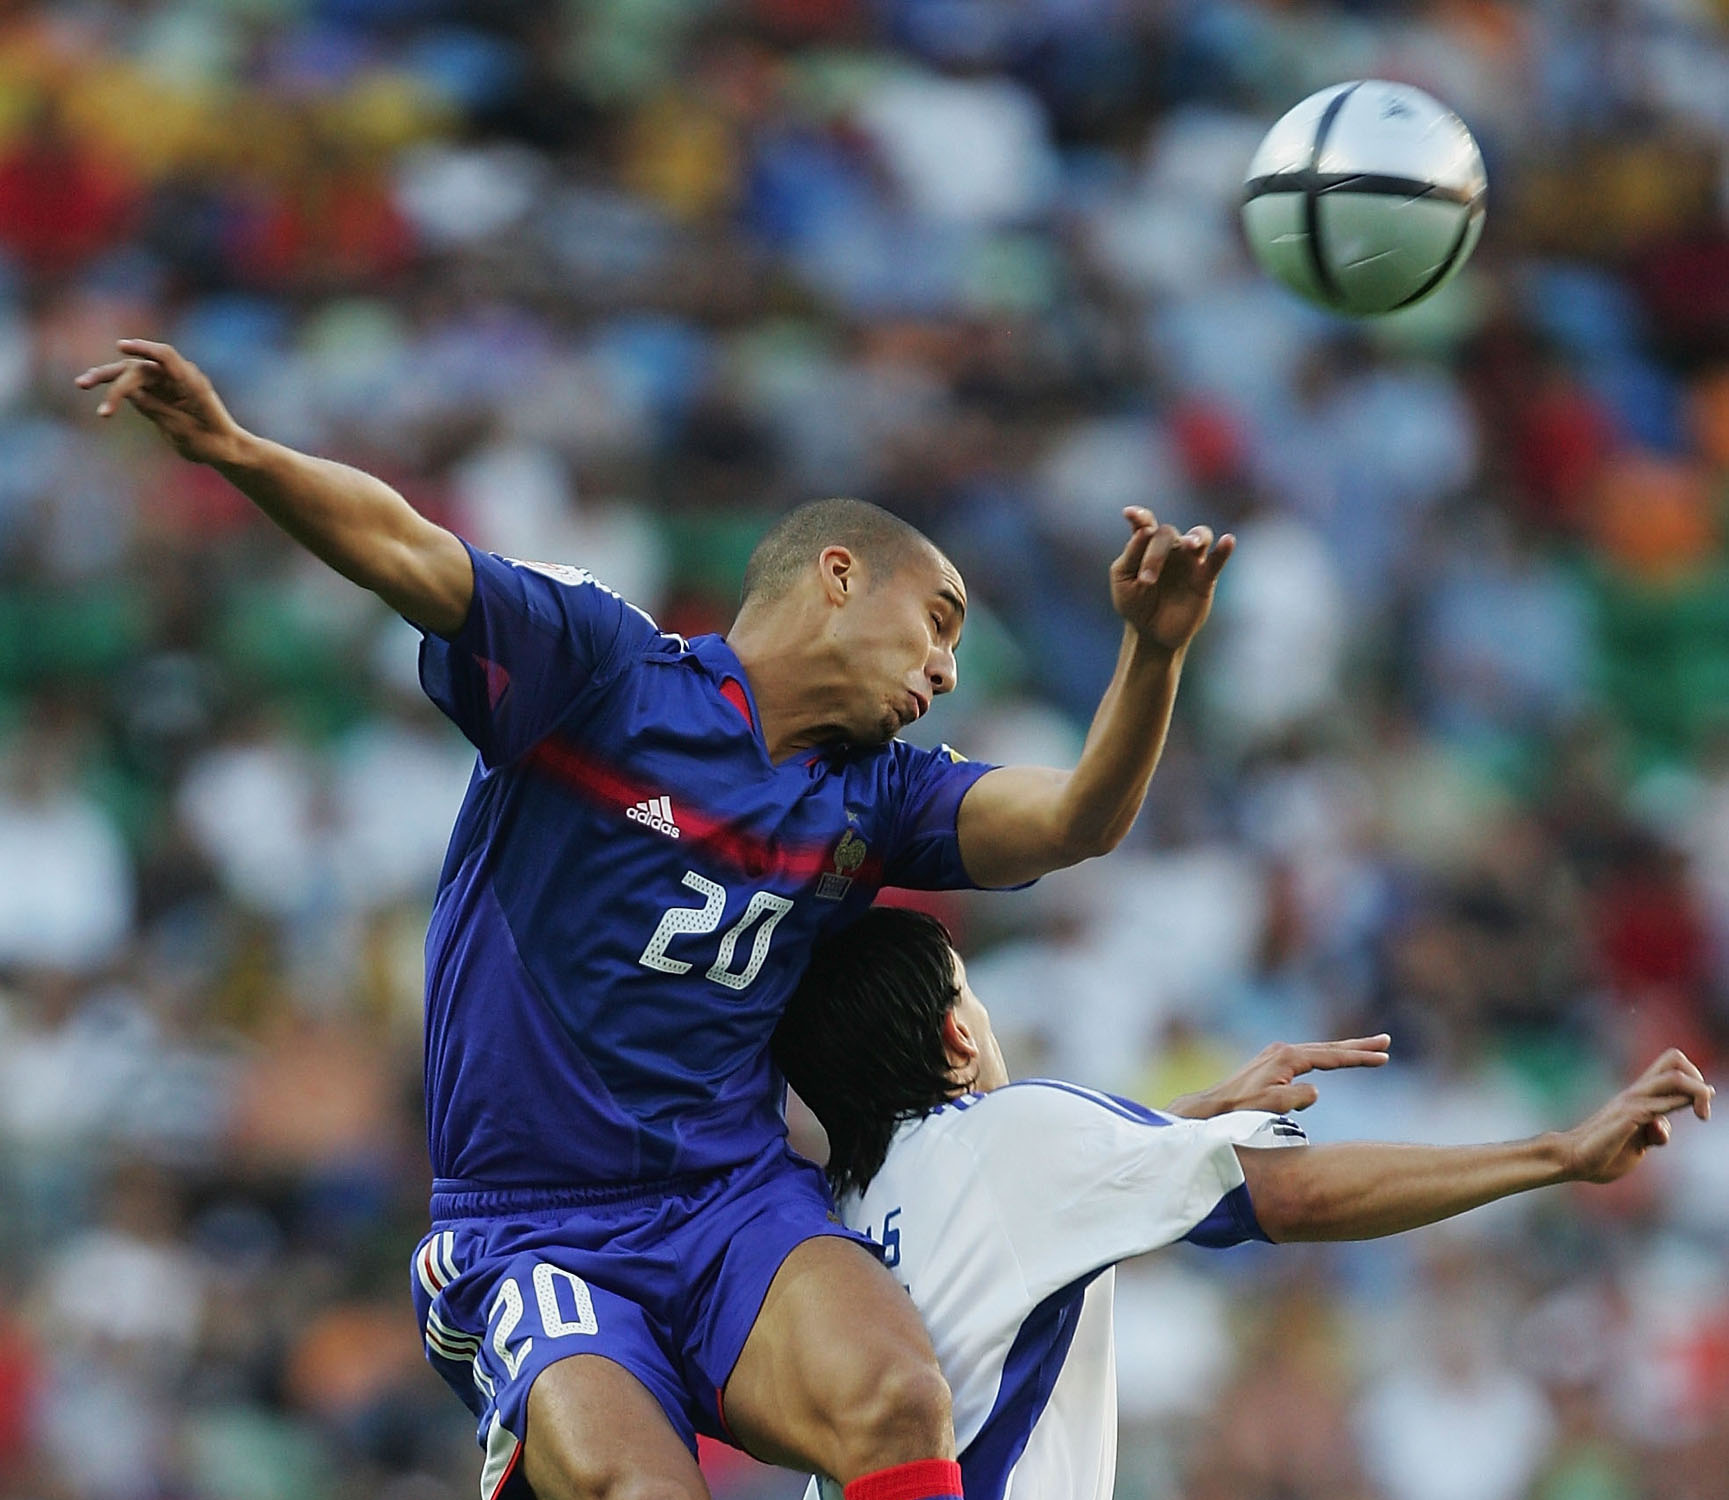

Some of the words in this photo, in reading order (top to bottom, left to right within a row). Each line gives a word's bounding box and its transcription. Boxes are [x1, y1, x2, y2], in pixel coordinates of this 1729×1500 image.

[626, 804, 681, 839] adidas
[638, 869, 795, 990] 20
[487, 1262, 600, 1381] 20
